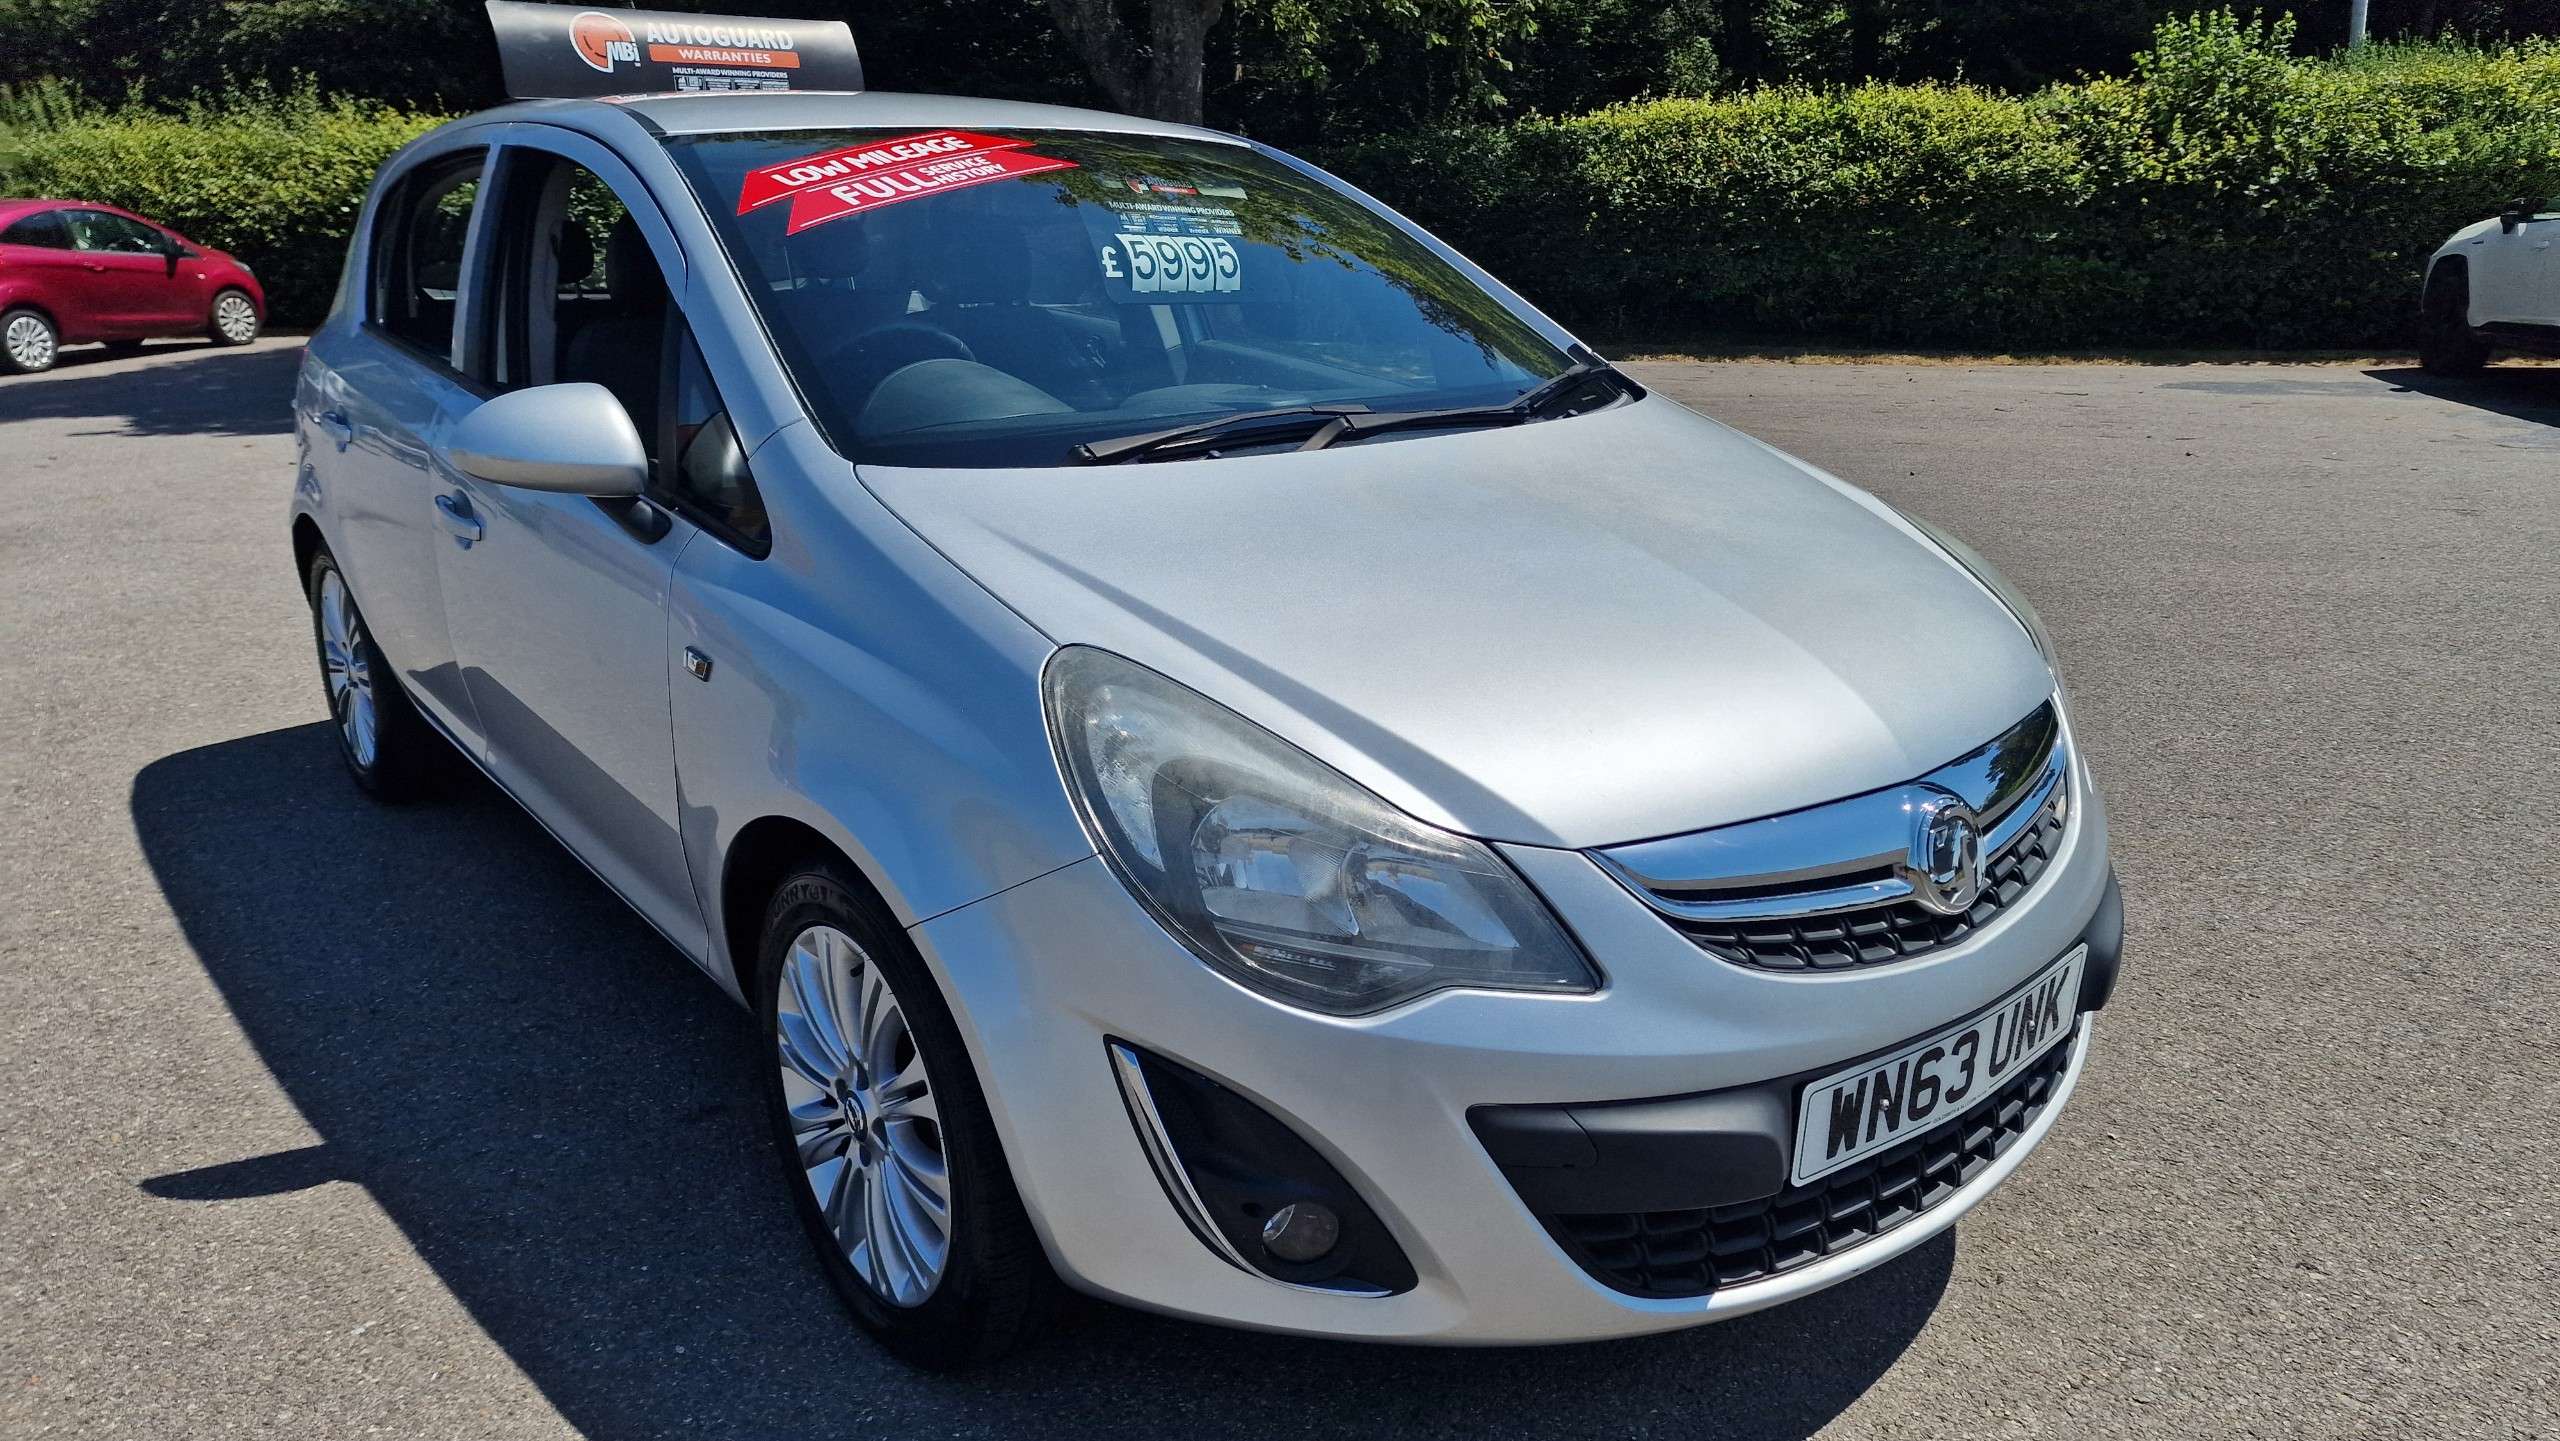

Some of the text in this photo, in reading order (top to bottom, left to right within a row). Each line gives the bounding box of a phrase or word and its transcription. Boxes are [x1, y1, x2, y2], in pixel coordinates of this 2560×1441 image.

[647, 22, 794, 49] AUTOGUARD
[678, 49, 772, 65] WARRANTIES
[672, 66, 788, 79] MULTI-AWARD WINNING PROVIDERS
[772, 136, 974, 187] LOW MILEAGE
[923, 155, 992, 177] SERVICE
[933, 163, 1008, 187] HISTORY
[831, 171, 938, 206] FULL
[1108, 201, 1235, 217] MULTI-AWARD WINNING PROVIDERS
[1826, 966, 2070, 1161] WN63 UNK
